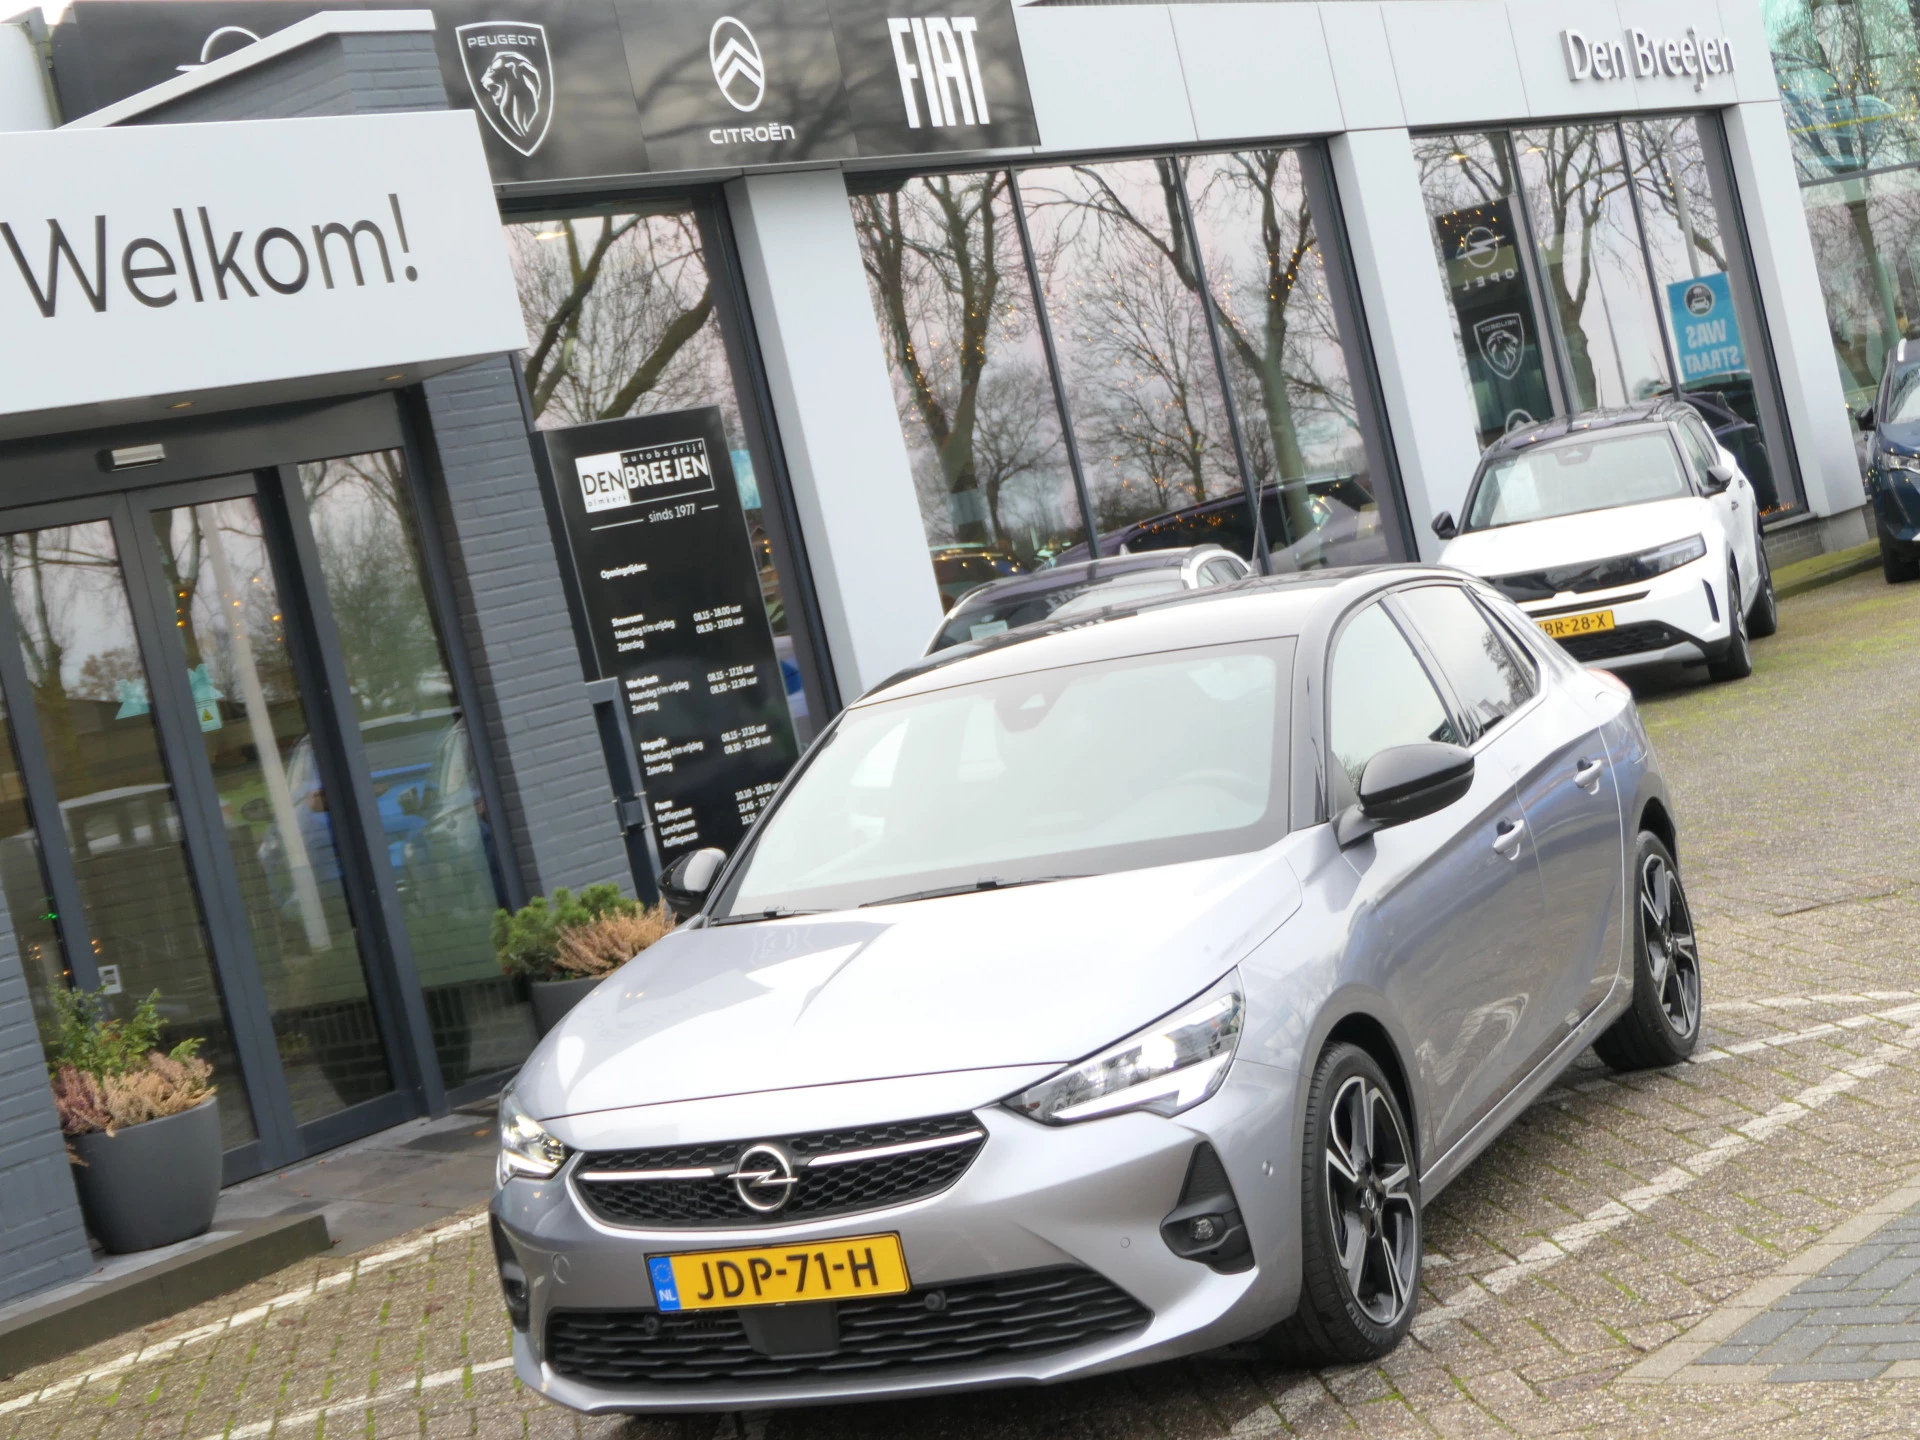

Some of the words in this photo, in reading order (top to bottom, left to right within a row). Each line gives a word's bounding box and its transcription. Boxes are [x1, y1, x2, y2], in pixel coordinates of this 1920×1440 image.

[466, 34, 538, 49] PEUGEOT
[1561, 28, 1629, 81] Den
[1627, 25, 1736, 92] Breejen
[888, 17, 990, 129] FIAT
[0, 192, 418, 318] Welkom!
[623, 442, 703, 464] autobedrijf
[582, 469, 625, 496] DEN
[624, 454, 709, 489] BREEJEN
[648, 508, 674, 523] sinds
[674, 503, 696, 518] 1977
[696, 622, 713, 634] 08.30
[1538, 614, 1606, 635] BR-28-X
[710, 683, 727, 694] 08.30
[724, 742, 741, 754] 08.30
[697, 1246, 879, 1301] JDP-71-H
[659, 1289, 676, 1302] NL
